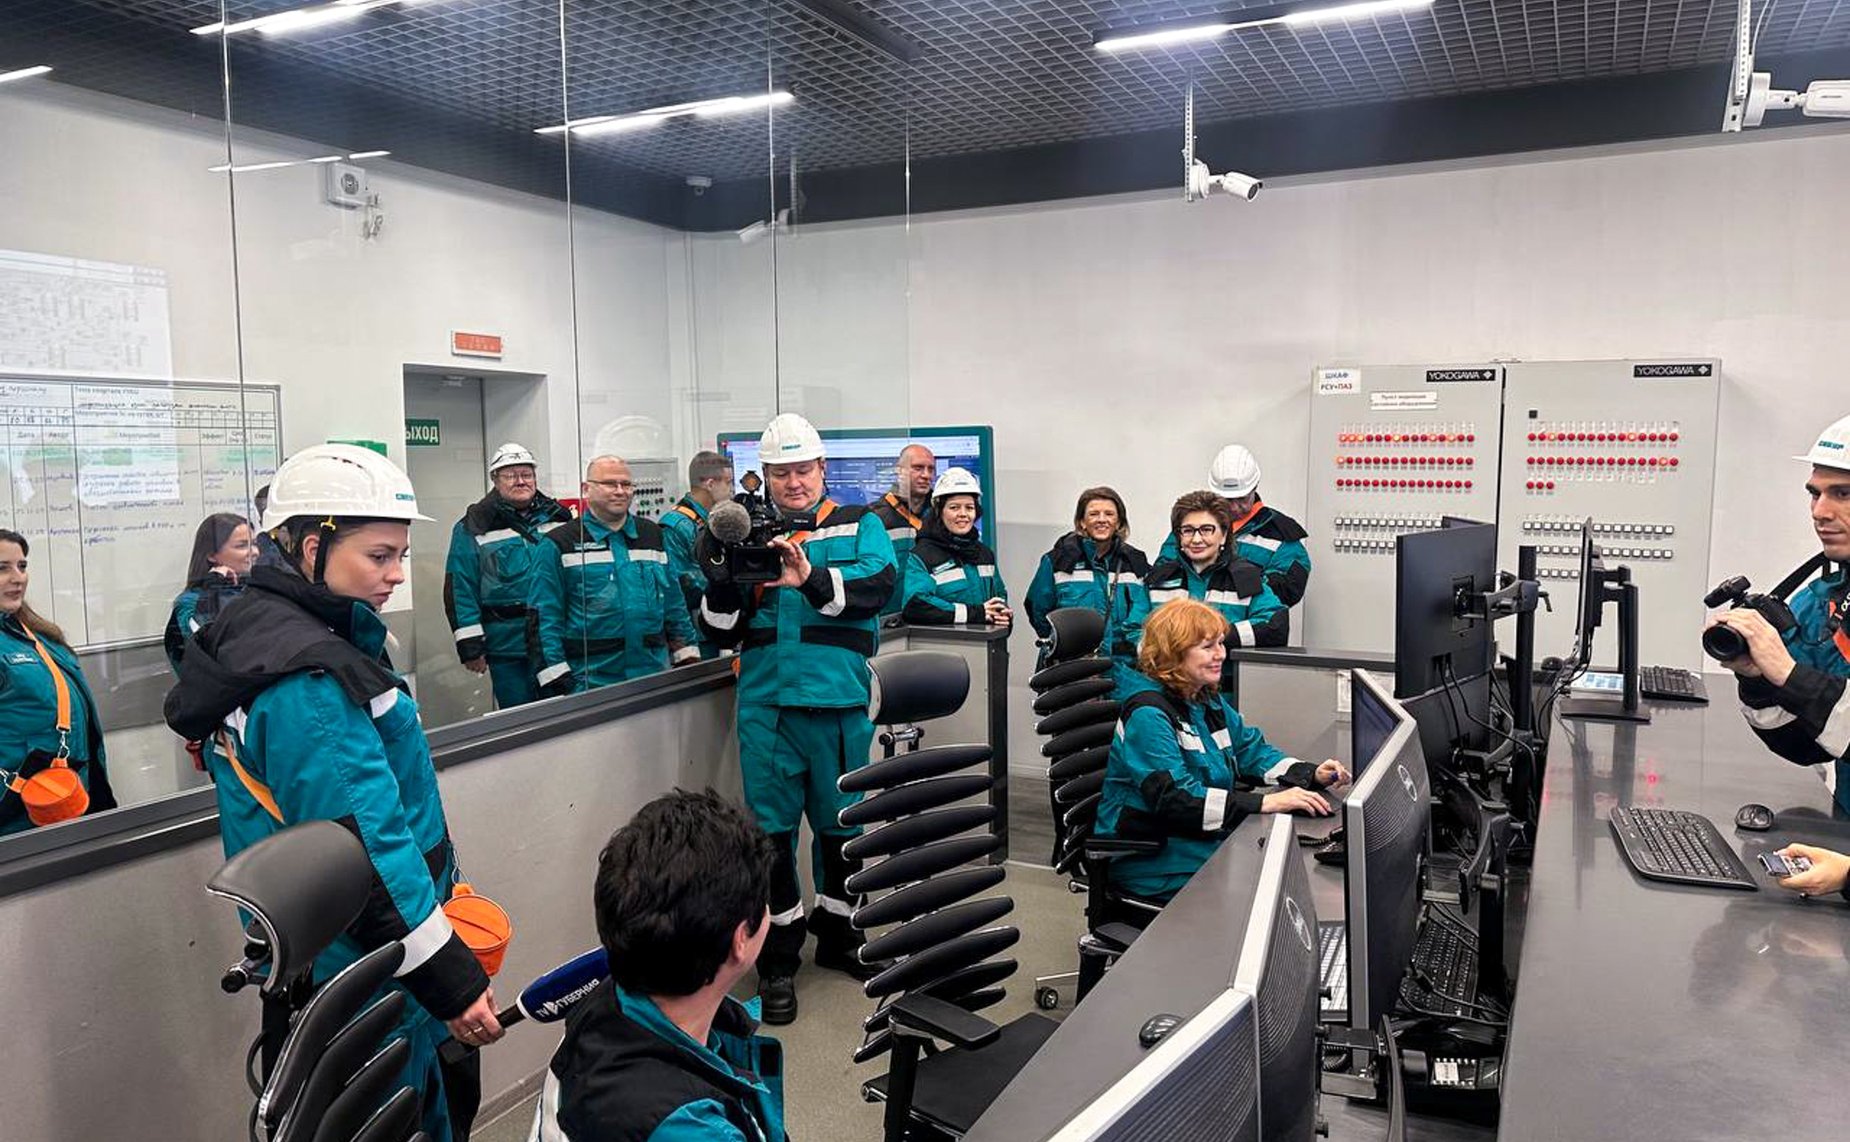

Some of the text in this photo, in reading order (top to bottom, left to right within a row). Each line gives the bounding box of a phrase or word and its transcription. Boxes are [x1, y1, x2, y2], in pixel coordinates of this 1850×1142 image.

[1325, 371, 1349, 379] ШКАФ
[1428, 371, 1480, 380] YOKOGAWA
[1636, 365, 1695, 376] YOKOGAWA
[405, 425, 439, 443] ЫХОД
[555, 978, 600, 1009] ГУБЕРНИЯ
